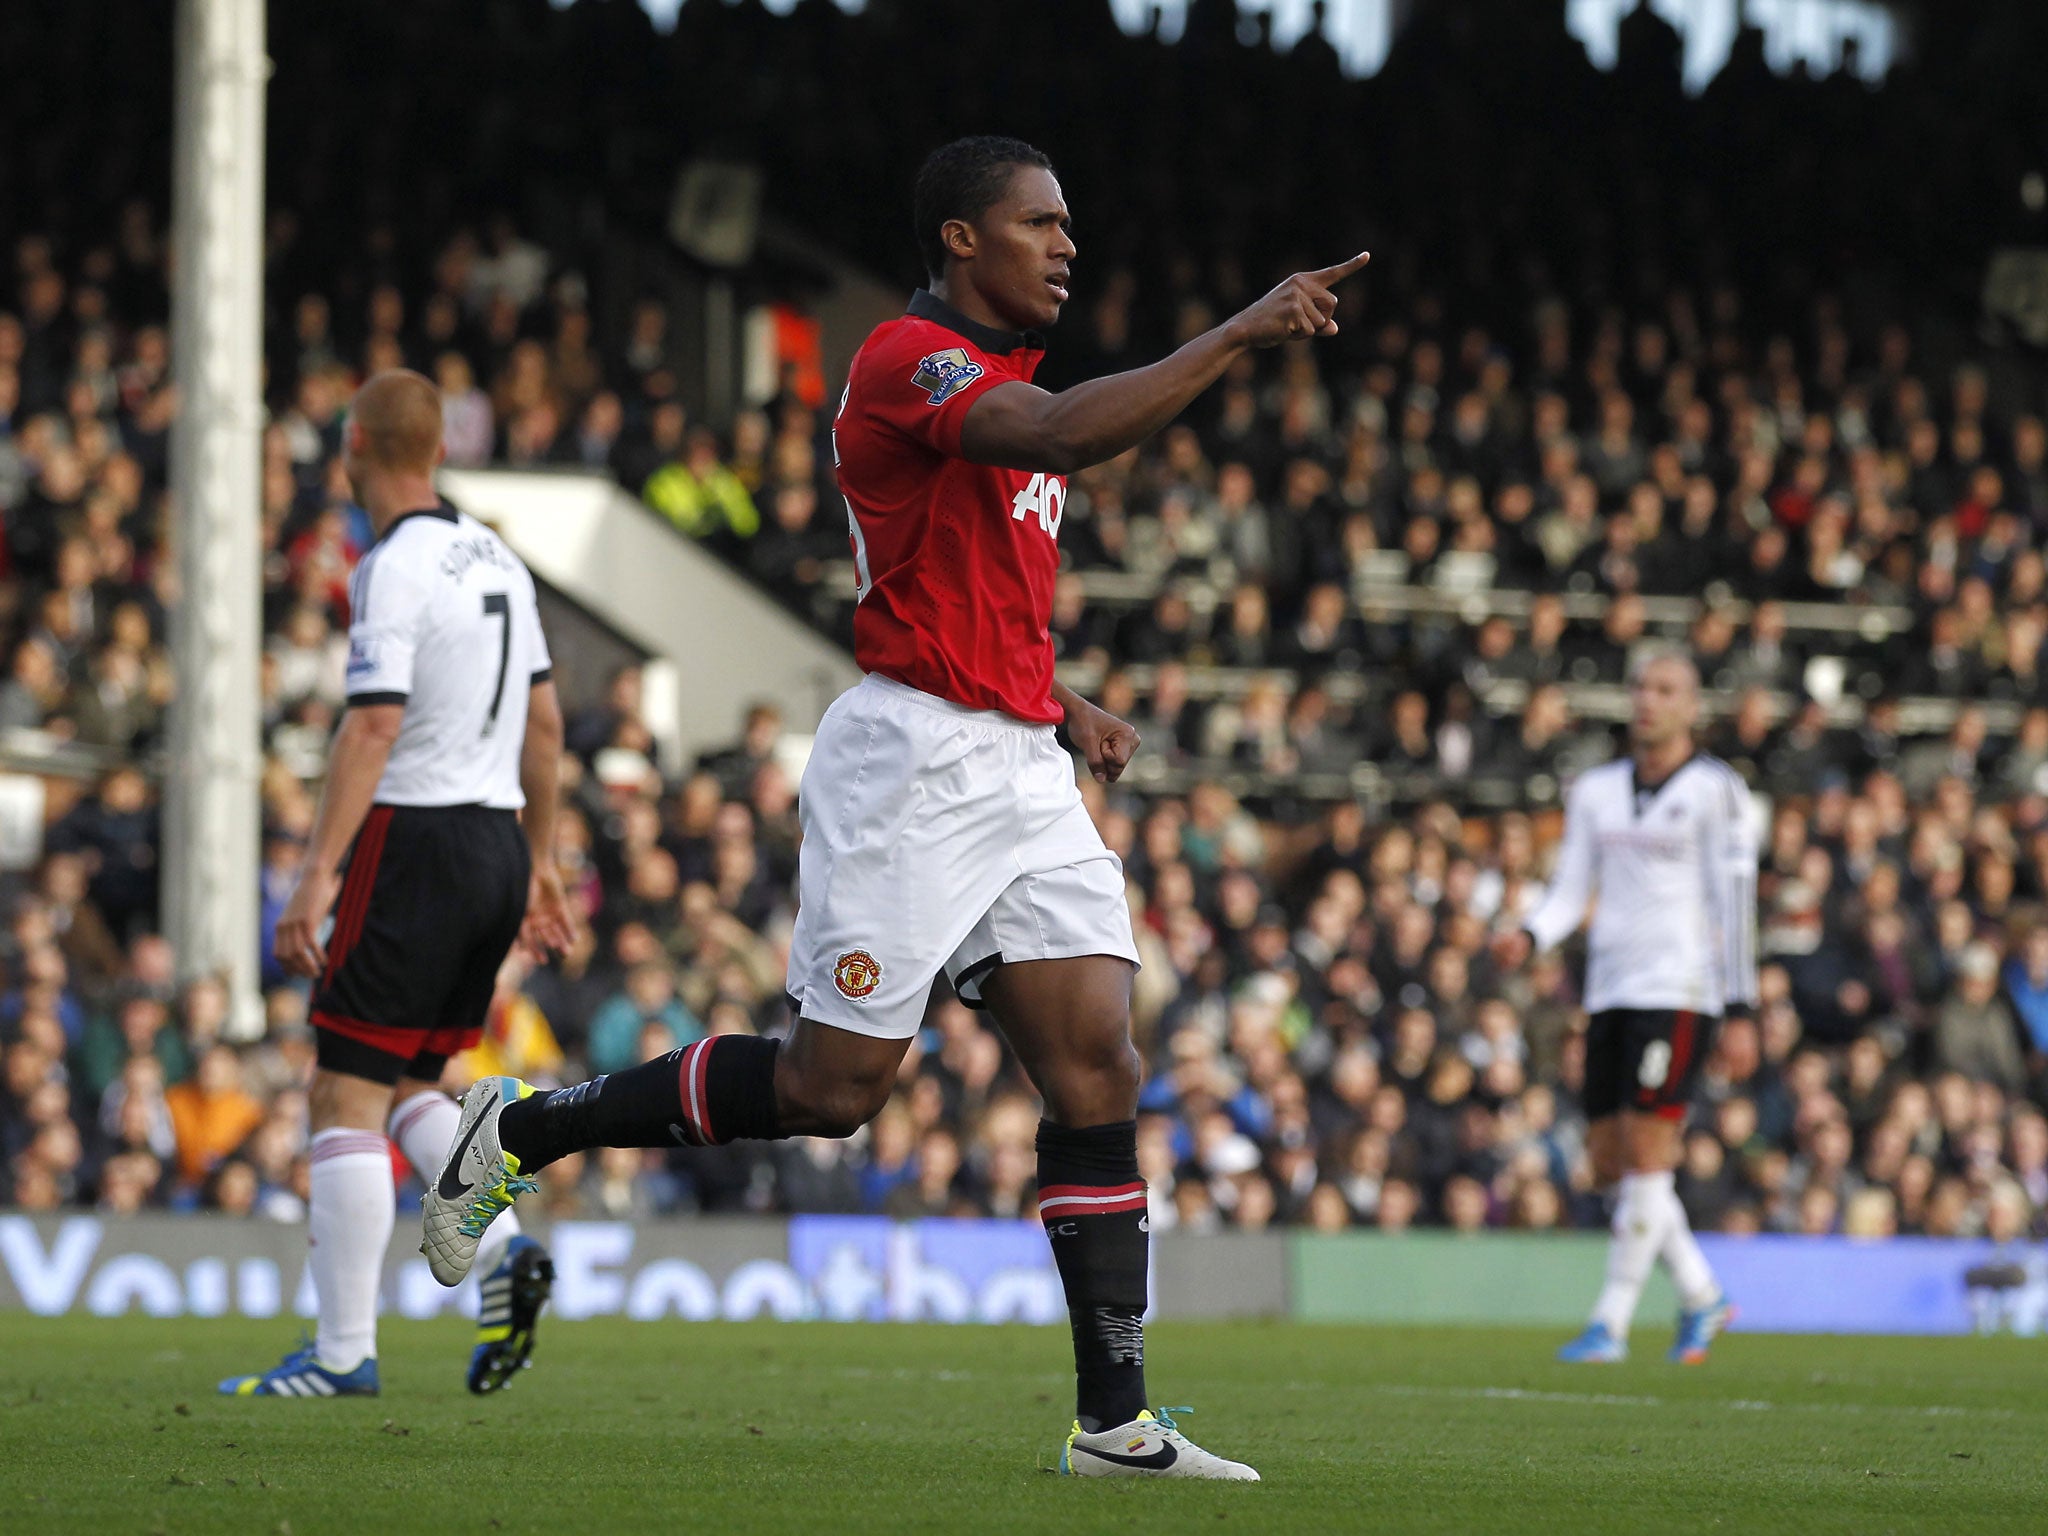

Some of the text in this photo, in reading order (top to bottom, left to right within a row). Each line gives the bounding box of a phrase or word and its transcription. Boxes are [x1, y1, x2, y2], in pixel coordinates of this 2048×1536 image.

[937, 368, 965, 397] BARCLAYS
[1012, 473, 1068, 540] AO
[482, 593, 511, 738] 7
[841, 953, 877, 976] MANCHESTER
[840, 983, 866, 996] UNITED
[1638, 1038, 1672, 1089] 8
[471, 1146, 484, 1166] AV7
[1047, 1222, 1078, 1240] FC
[551, 1221, 1157, 1325] Footba
